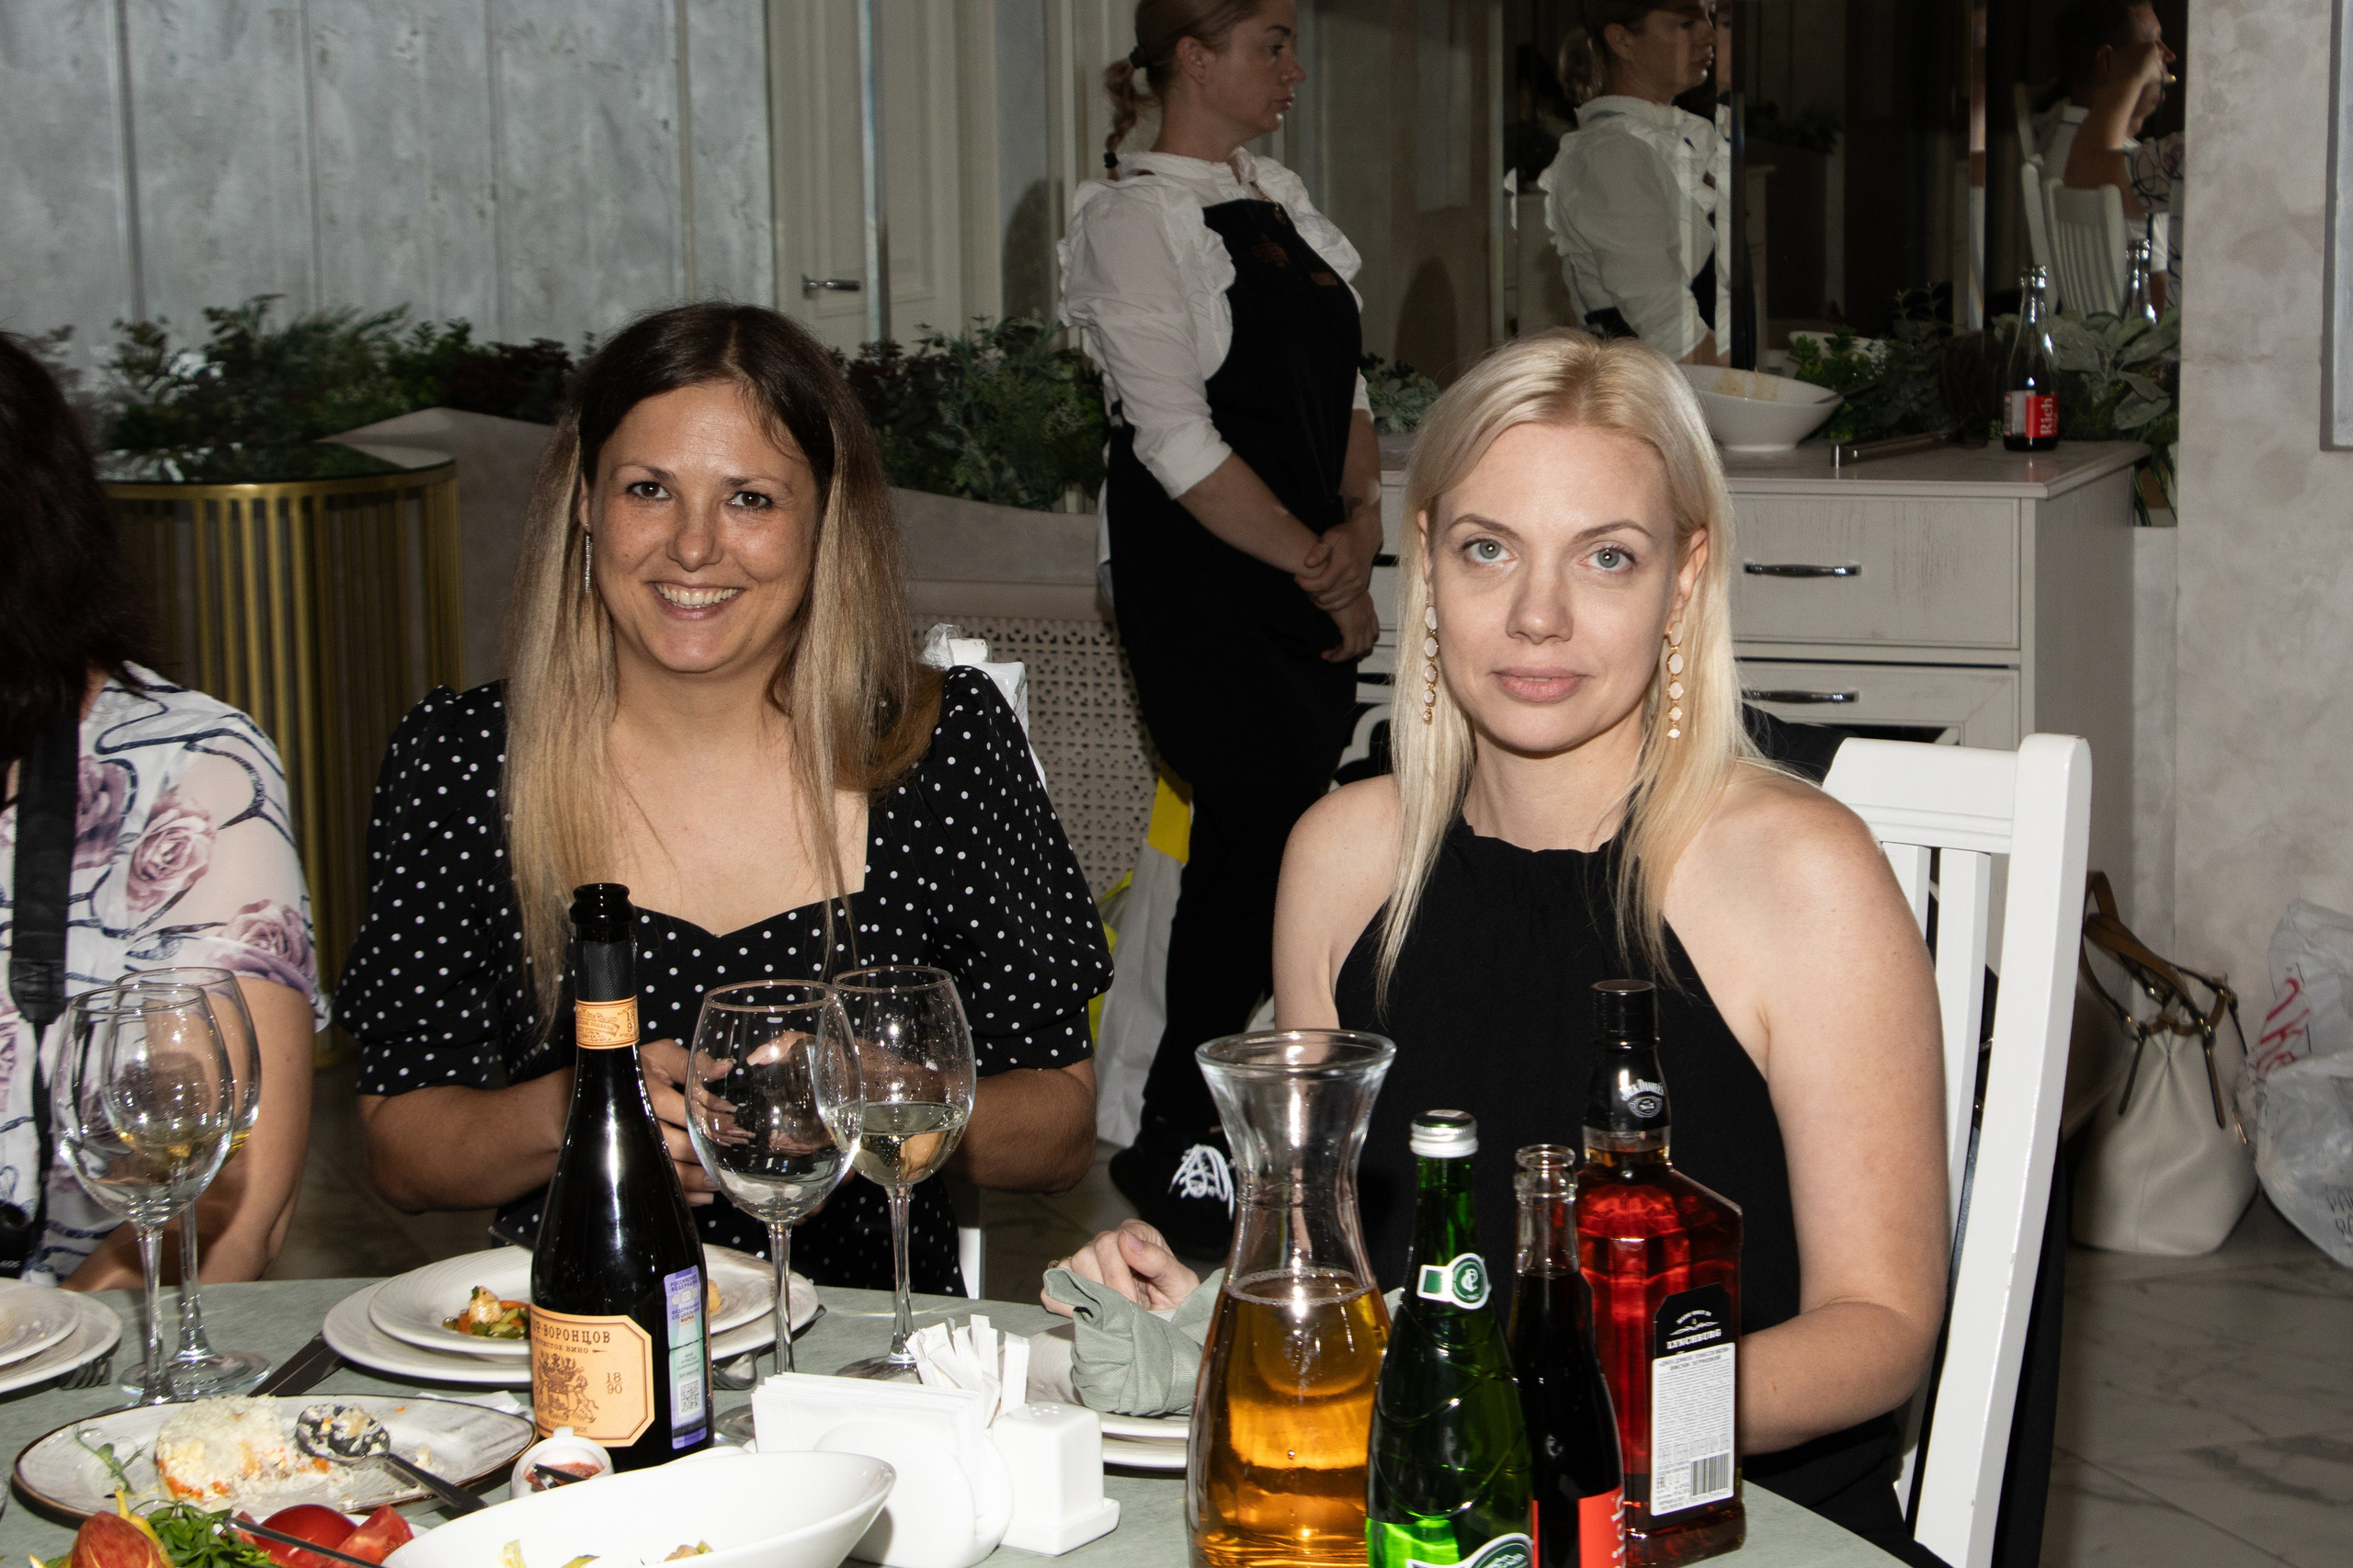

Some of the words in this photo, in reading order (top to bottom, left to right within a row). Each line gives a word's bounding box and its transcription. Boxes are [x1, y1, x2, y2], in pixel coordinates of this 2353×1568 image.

[2040, 397, 2053, 435] Rich
[680, 1314, 694, 1323] МАРКА
[1666, 1328, 1722, 1349] LYNCHBURG
[566, 1346, 588, 1354] ВИНО
[606, 1372, 621, 1382] 18
[607, 1383, 623, 1394] 90
